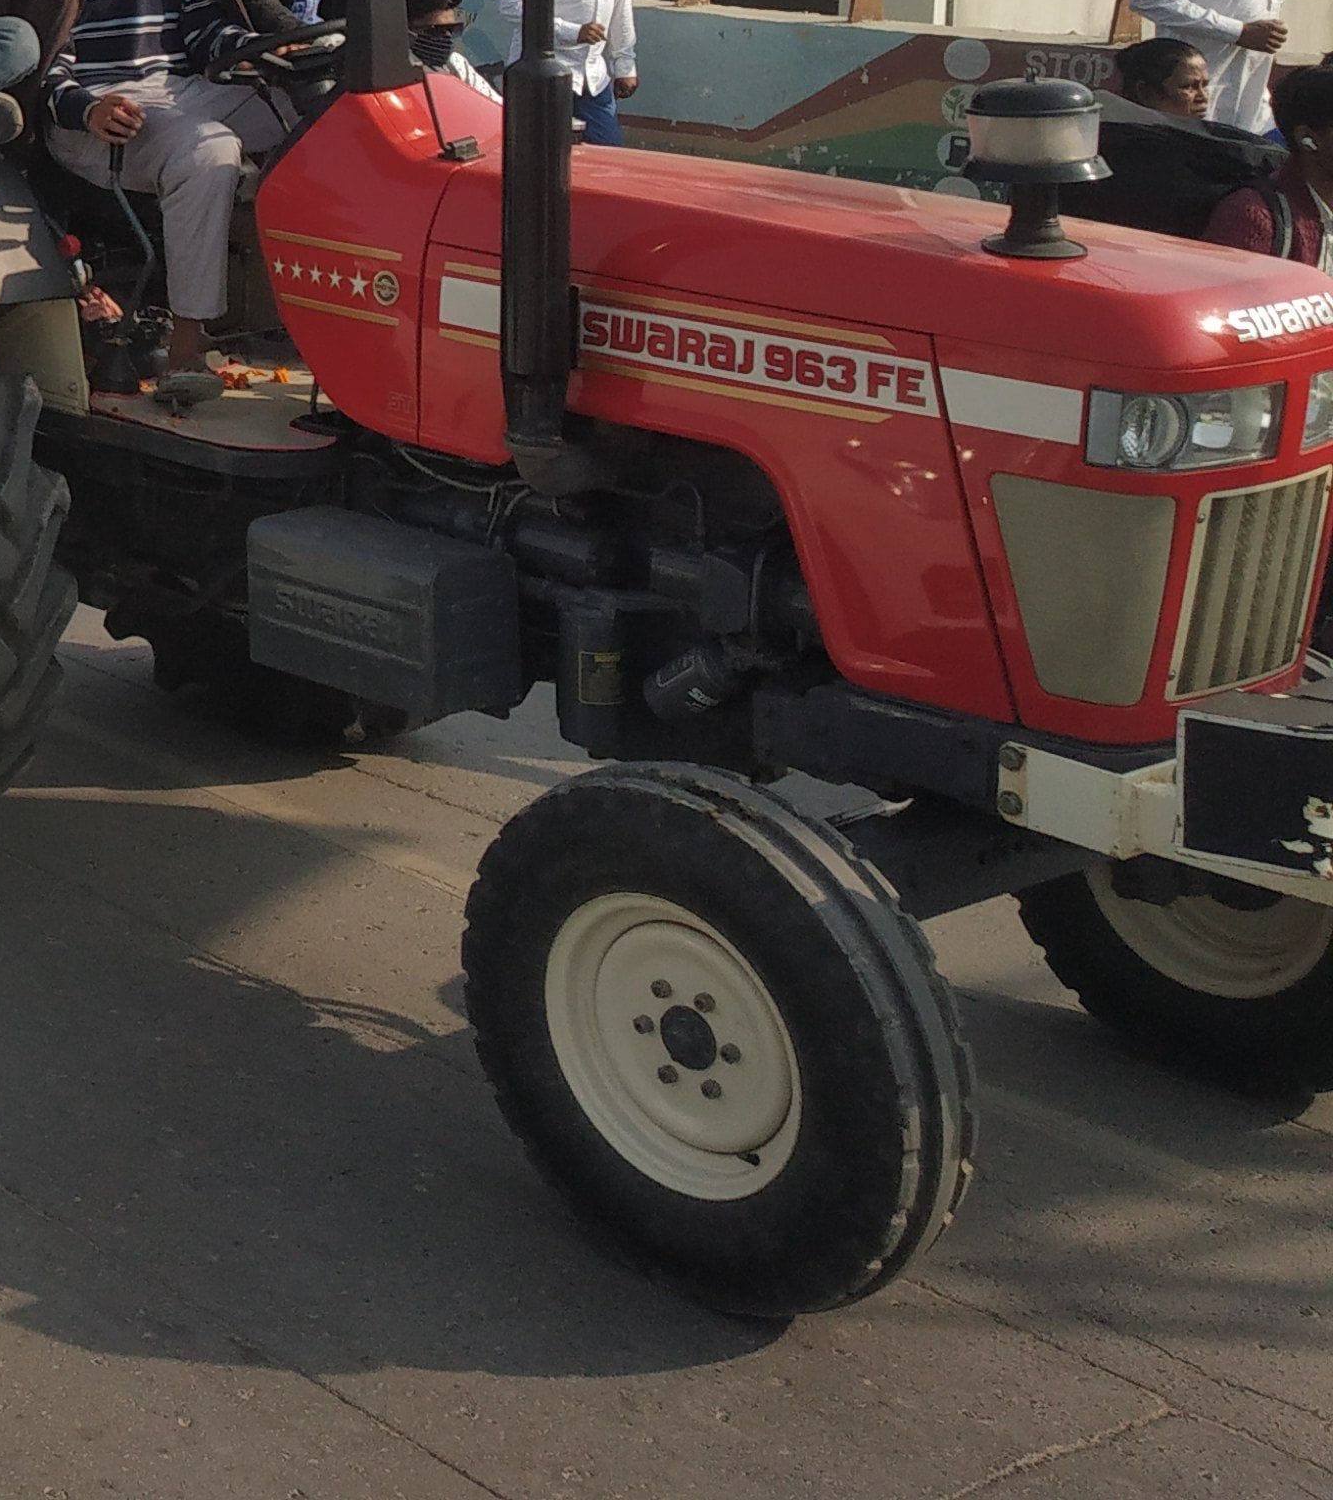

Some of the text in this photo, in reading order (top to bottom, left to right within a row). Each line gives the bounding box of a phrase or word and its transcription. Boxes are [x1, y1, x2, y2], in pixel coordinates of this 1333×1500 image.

[1024, 49, 1114, 88] STOP
[763, 343, 857, 394] 963
[866, 361, 927, 408] FE
